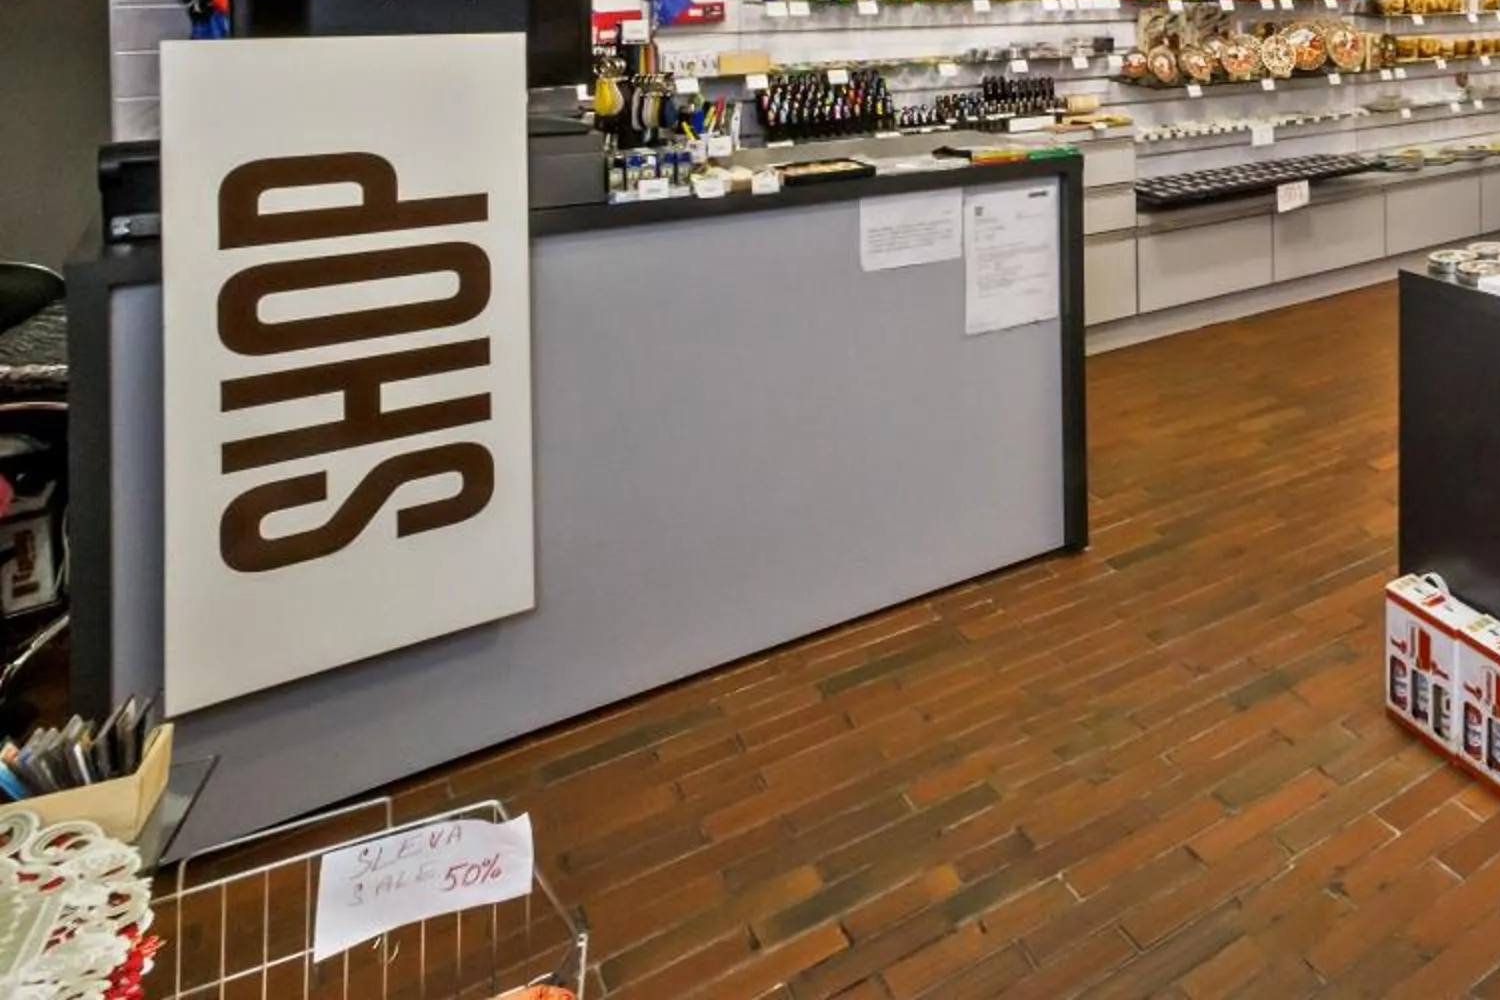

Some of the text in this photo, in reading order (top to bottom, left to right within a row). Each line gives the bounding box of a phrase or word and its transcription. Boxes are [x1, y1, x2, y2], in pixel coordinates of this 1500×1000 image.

[218, 152, 494, 573] SHOP
[348, 825, 462, 879] SLEVA
[346, 854, 502, 907] SALE 50%
